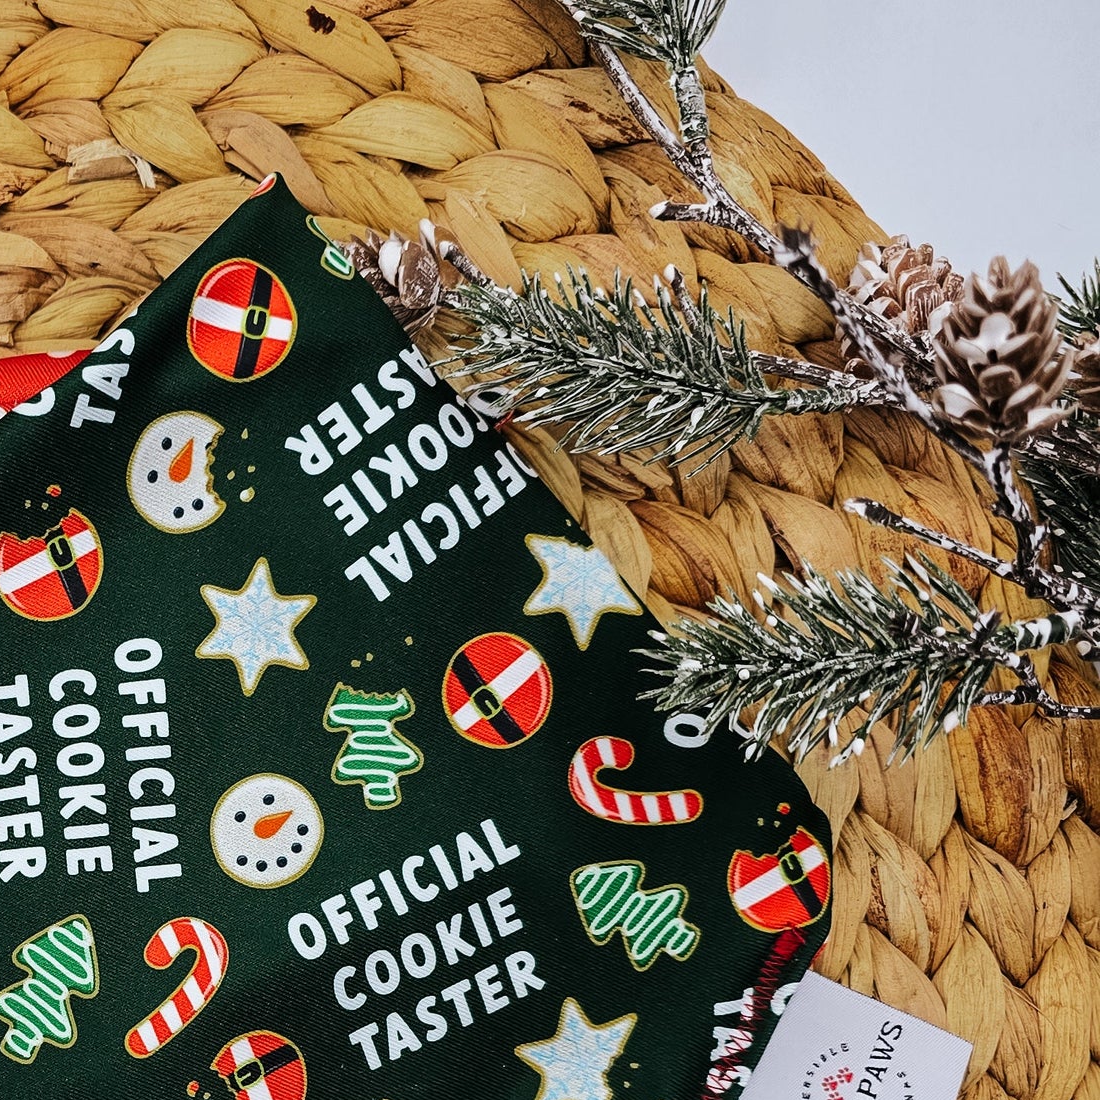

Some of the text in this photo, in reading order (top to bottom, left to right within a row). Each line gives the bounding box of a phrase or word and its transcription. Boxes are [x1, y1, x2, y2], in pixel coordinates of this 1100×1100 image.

[69, 307, 138, 429] TAS
[284, 343, 437, 476] ASTER
[48, 668, 114, 876] COOKIE
[113, 637, 183, 893] OFFICIAL
[287, 818, 521, 960] OFFICIAL
[333, 886, 523, 1011] COOKIE
[348, 950, 546, 1071] TASTER
[856, 1020, 904, 1100] PAWS
